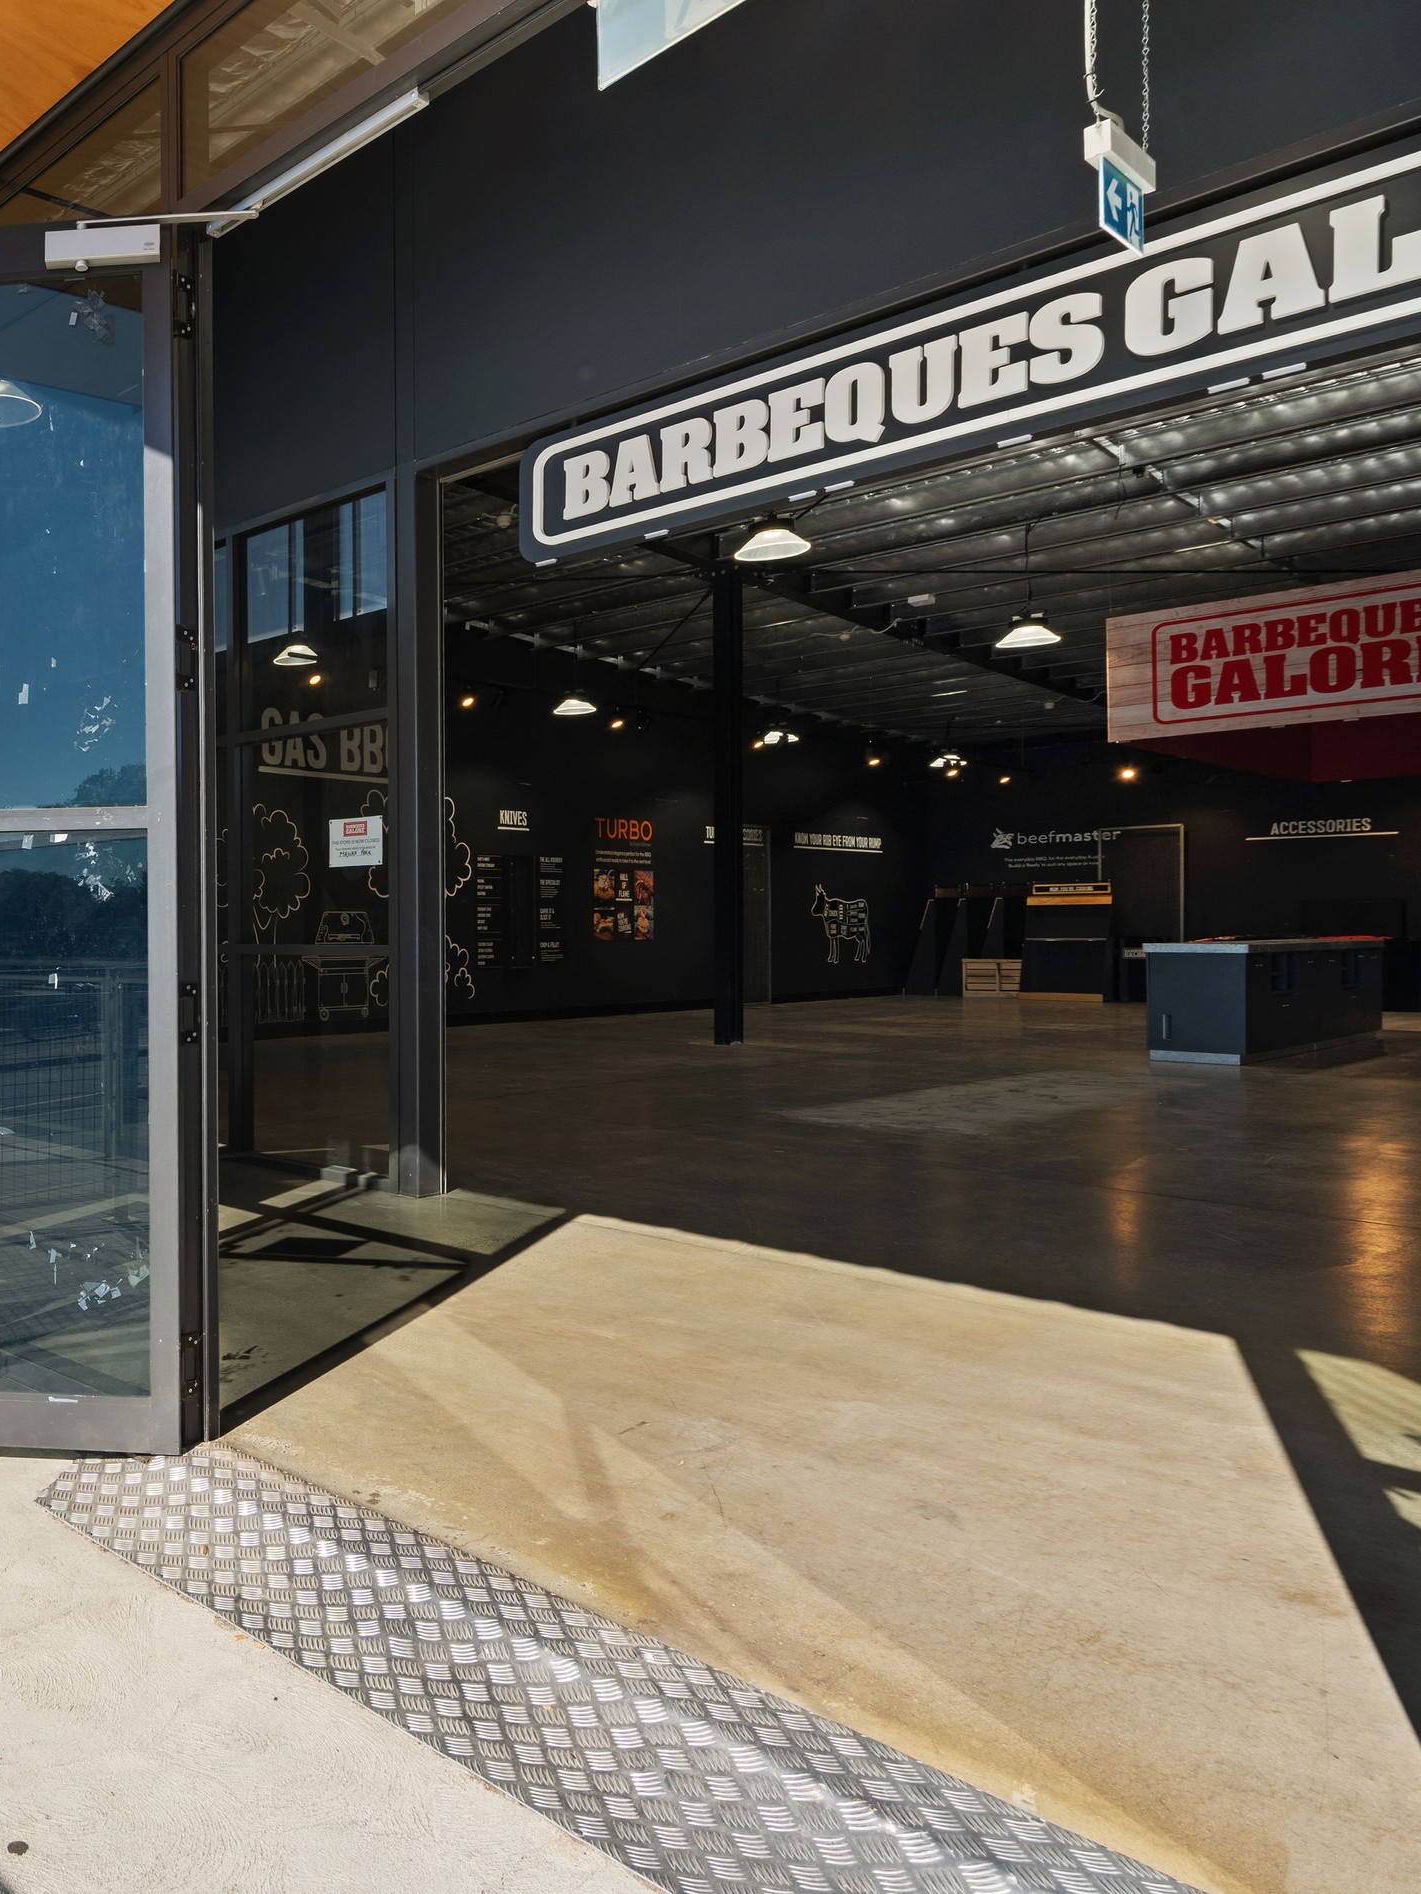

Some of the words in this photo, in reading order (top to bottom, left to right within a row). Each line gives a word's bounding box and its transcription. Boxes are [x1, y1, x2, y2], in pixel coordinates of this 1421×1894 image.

[563, 292, 1106, 521] BARBEQUES
[1170, 635, 1421, 710] GALOR
[261, 707, 327, 770] GAS
[340, 724, 388, 774] BB
[500, 810, 527, 826] KNIVES
[1270, 817, 1372, 836] ACCESSORIES
[595, 817, 653, 842] TURBO
[742, 828, 763, 842] SORIES
[1017, 829, 1121, 845] beefmaster
[794, 832, 809, 845] KNOW
[809, 833, 822, 845] YOUR
[832, 834, 842, 847] EYE
[842, 835, 855, 848] FROM
[856, 836, 868, 848] YOUR
[869, 837, 882, 849] RUMP
